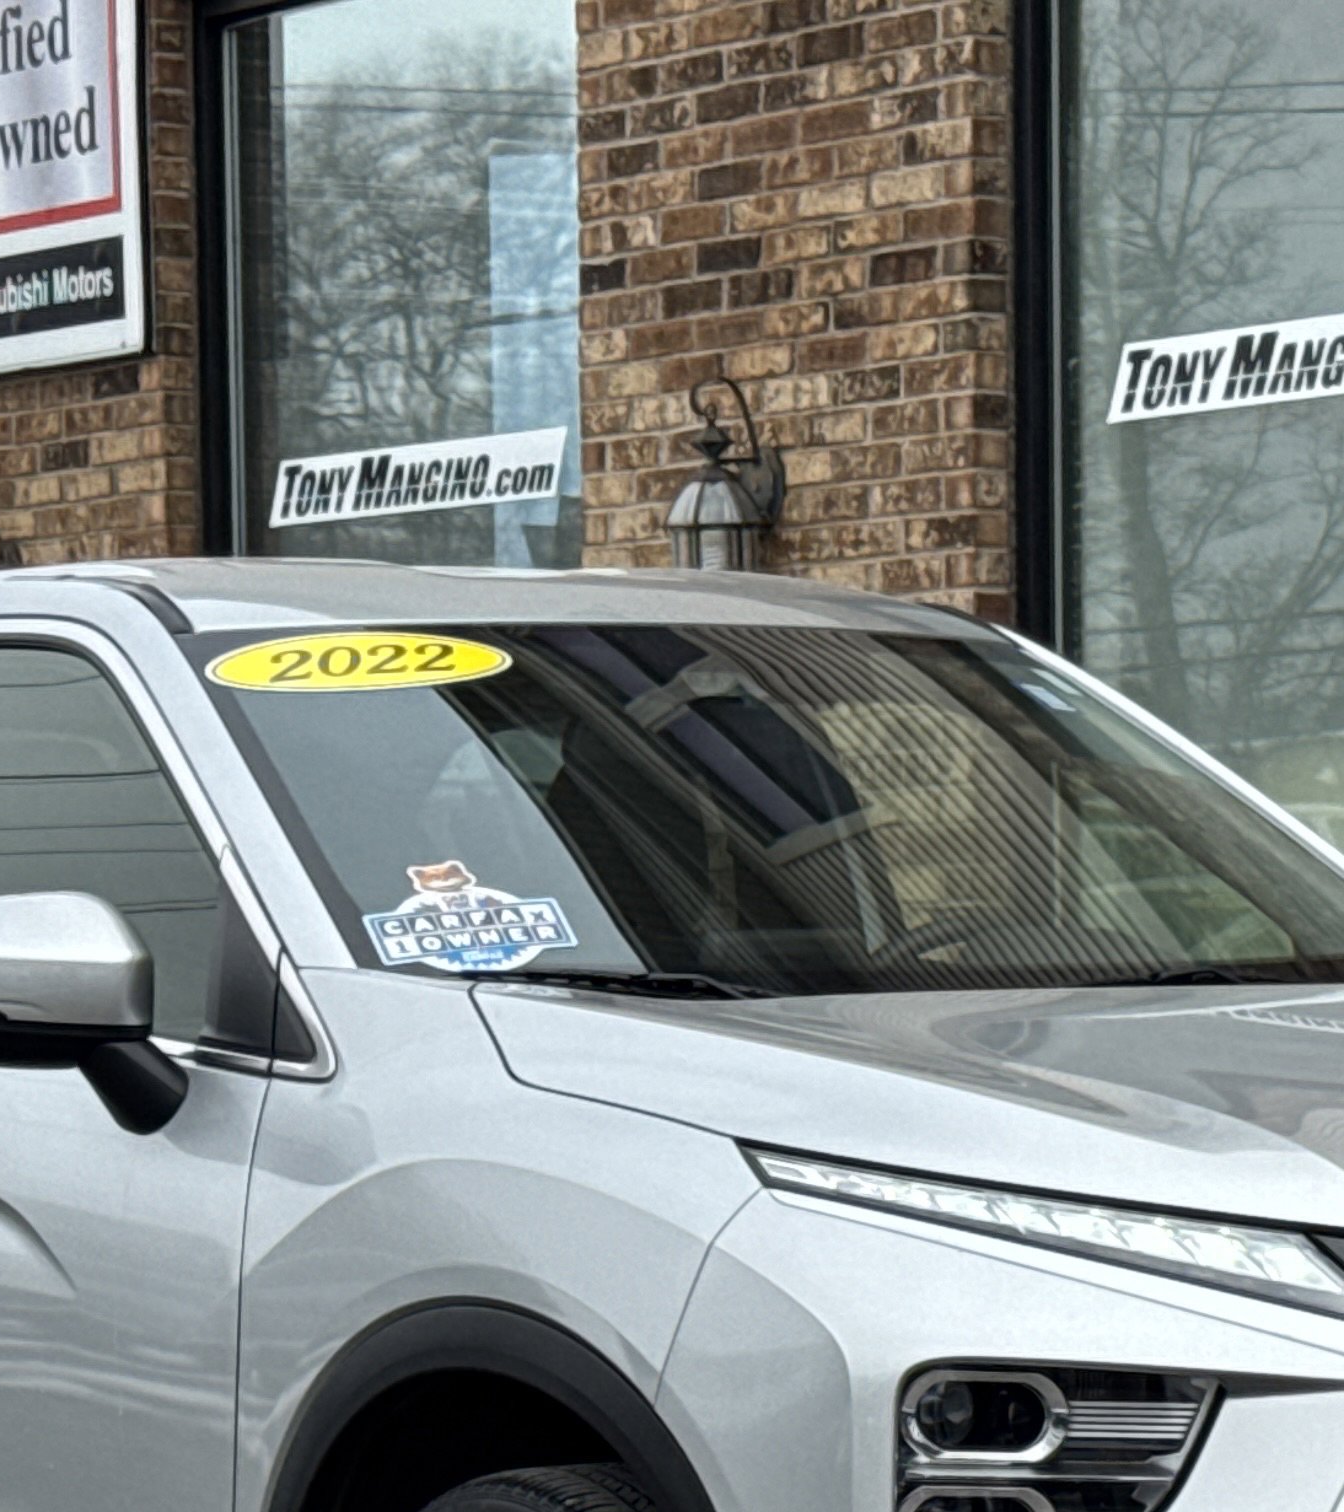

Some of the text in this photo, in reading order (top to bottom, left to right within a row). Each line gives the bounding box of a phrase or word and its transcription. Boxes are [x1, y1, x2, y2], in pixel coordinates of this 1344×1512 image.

[53, 266, 114, 305] Motors
[269, 642, 457, 684] 2022
[382, 909, 551, 935] CARFAX
[420, 926, 559, 951] OWNER
